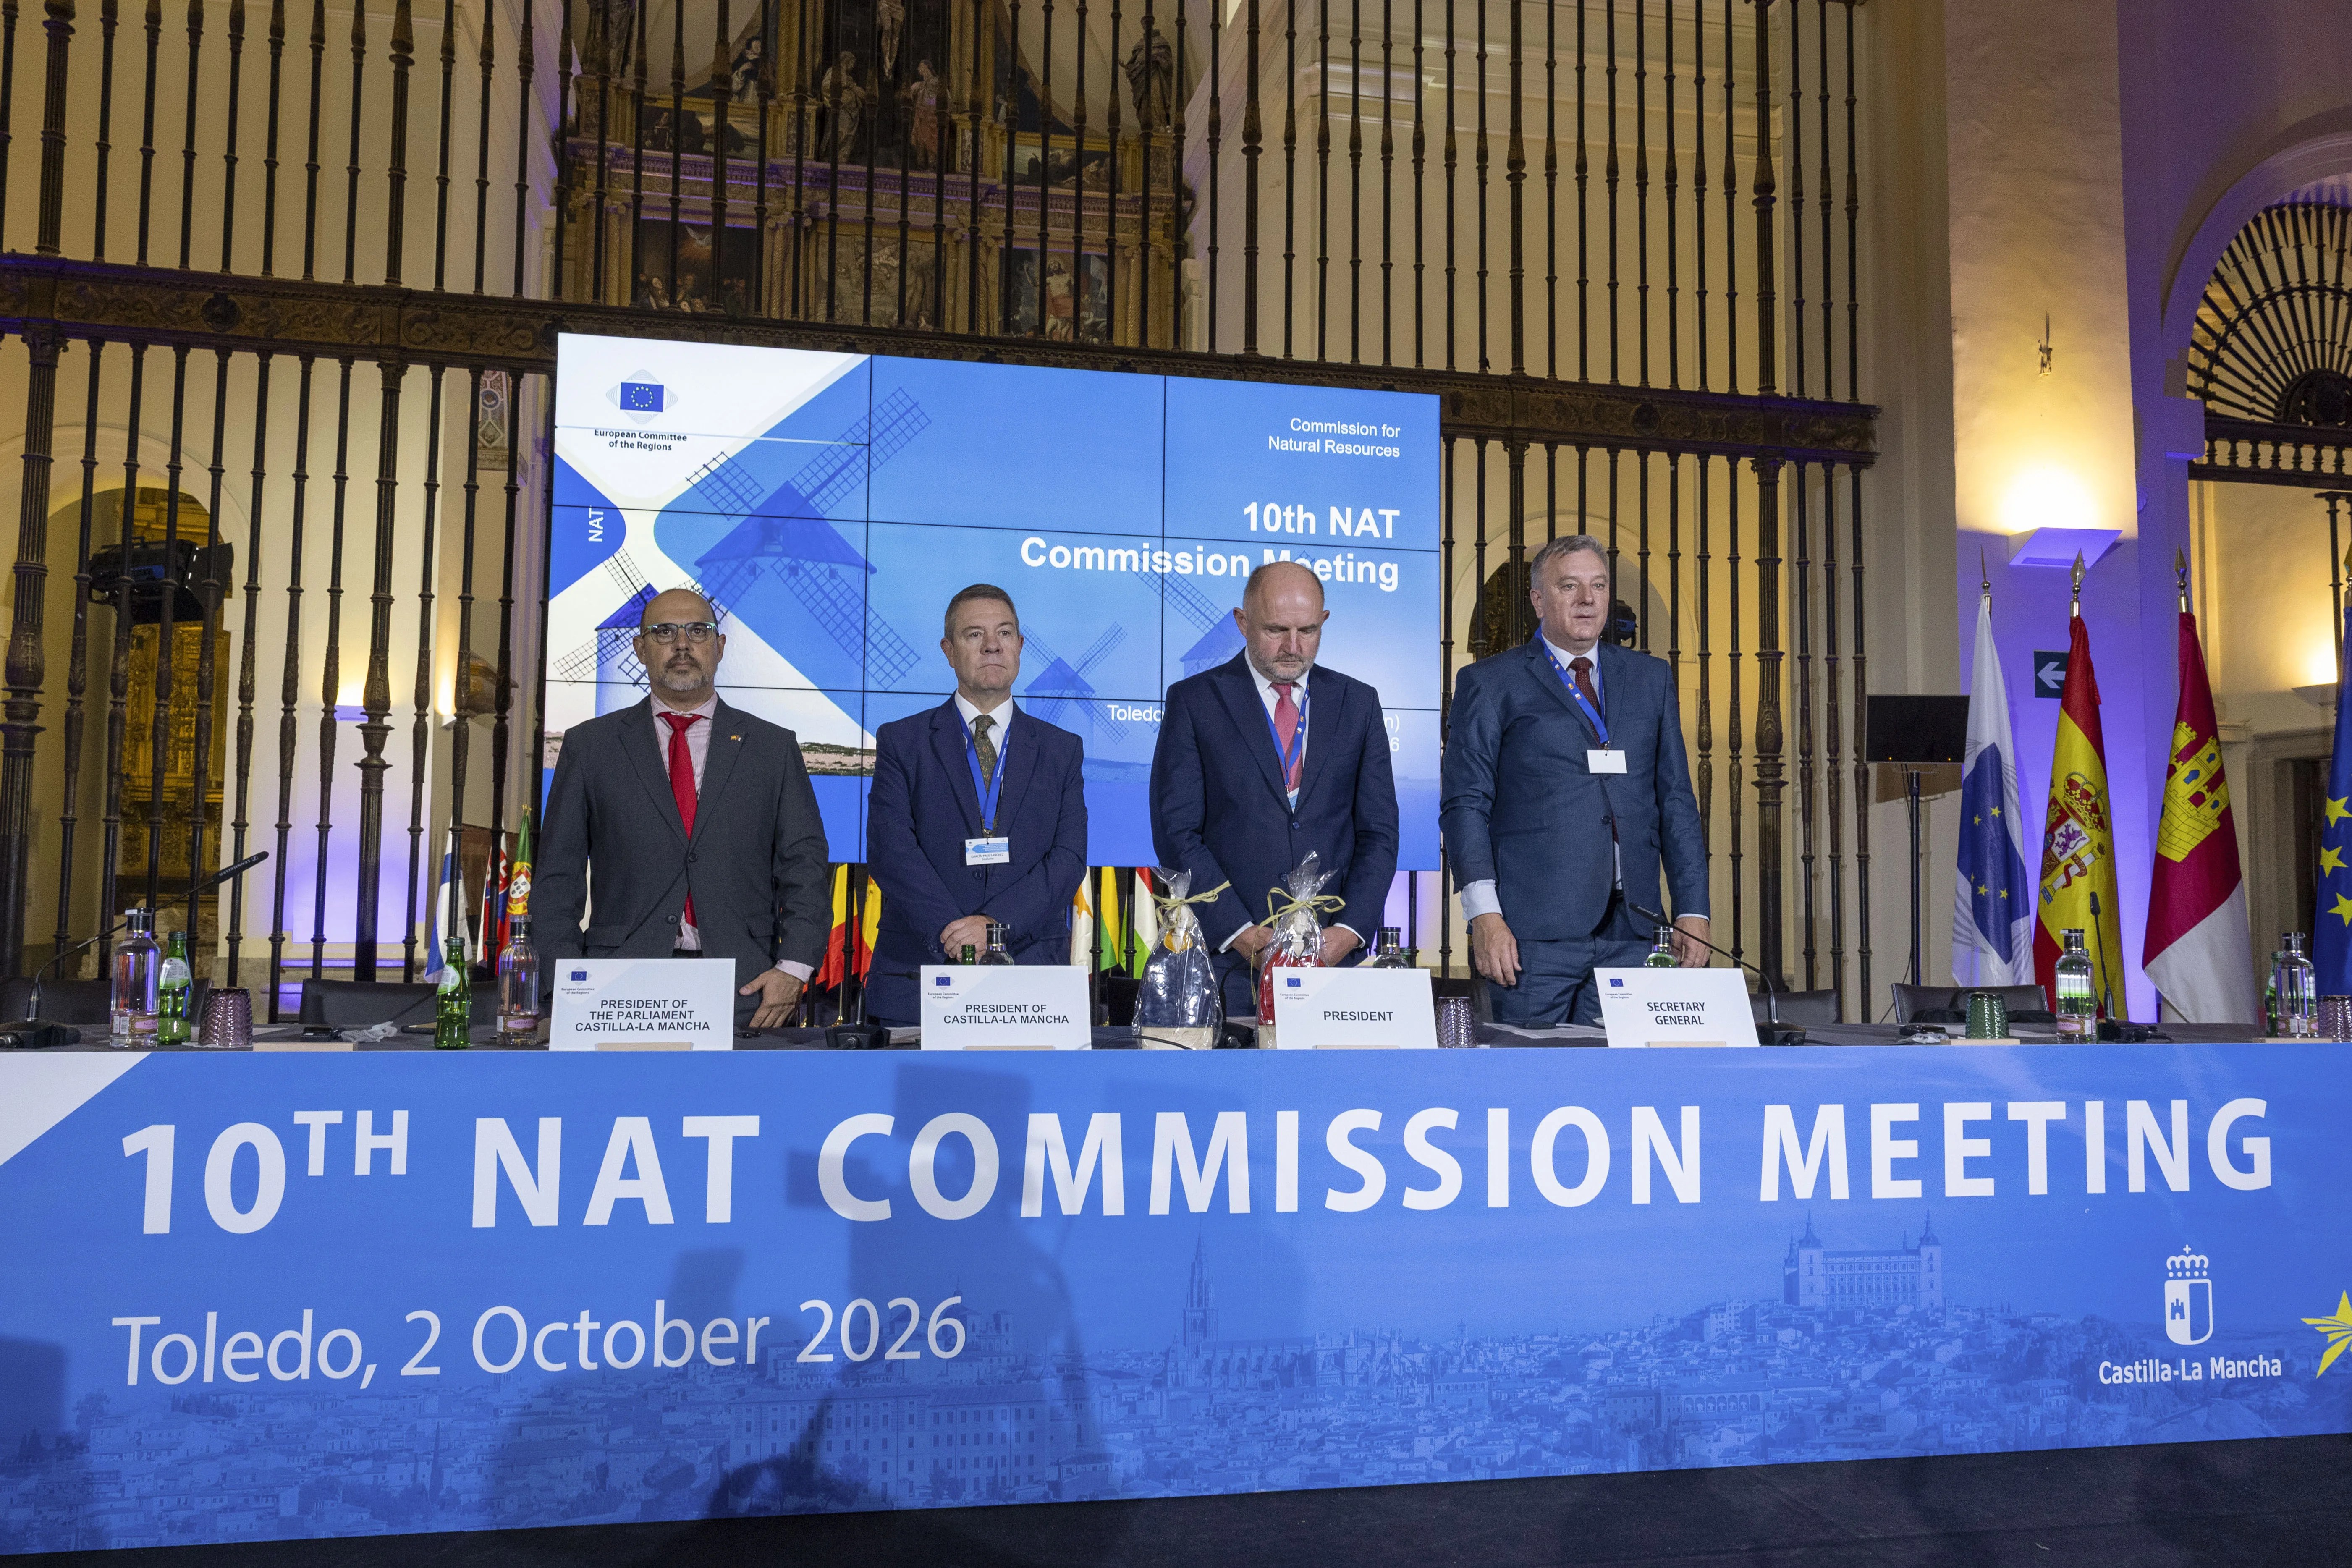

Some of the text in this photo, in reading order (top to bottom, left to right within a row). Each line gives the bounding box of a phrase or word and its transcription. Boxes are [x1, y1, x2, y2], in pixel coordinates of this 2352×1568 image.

[1290, 417, 1401, 437] Commission for
[594, 429, 687, 441] European Committee
[620, 440, 635, 448] the
[637, 441, 672, 451] Regions
[1268, 435, 1401, 458] Natural Resources
[588, 505, 604, 542] NAT
[1244, 501, 1400, 539] 10th NAT
[1021, 537, 1249, 578] Commission
[601, 1000, 688, 1008] PRESIDENT OF
[966, 1004, 1047, 1013] PRESIDENT OF
[1647, 1002, 1705, 1011] SECRETARY
[589, 1010, 694, 1020] THE PARLIAMENT
[944, 1015, 1069, 1024] CASTILLA-LA MANCHA
[1323, 1011, 1393, 1021] PRESIDENT
[1655, 1015, 1705, 1025] GENERAL
[575, 1021, 710, 1031] CASTILLA-LA MANCHA
[122, 1098, 2272, 1235] 10TH NAT COMMISSION MEETING
[112, 1296, 967, 1390] Toledo, 2 October 2026
[2099, 1354, 2282, 1385] Castilla-La Mancha
